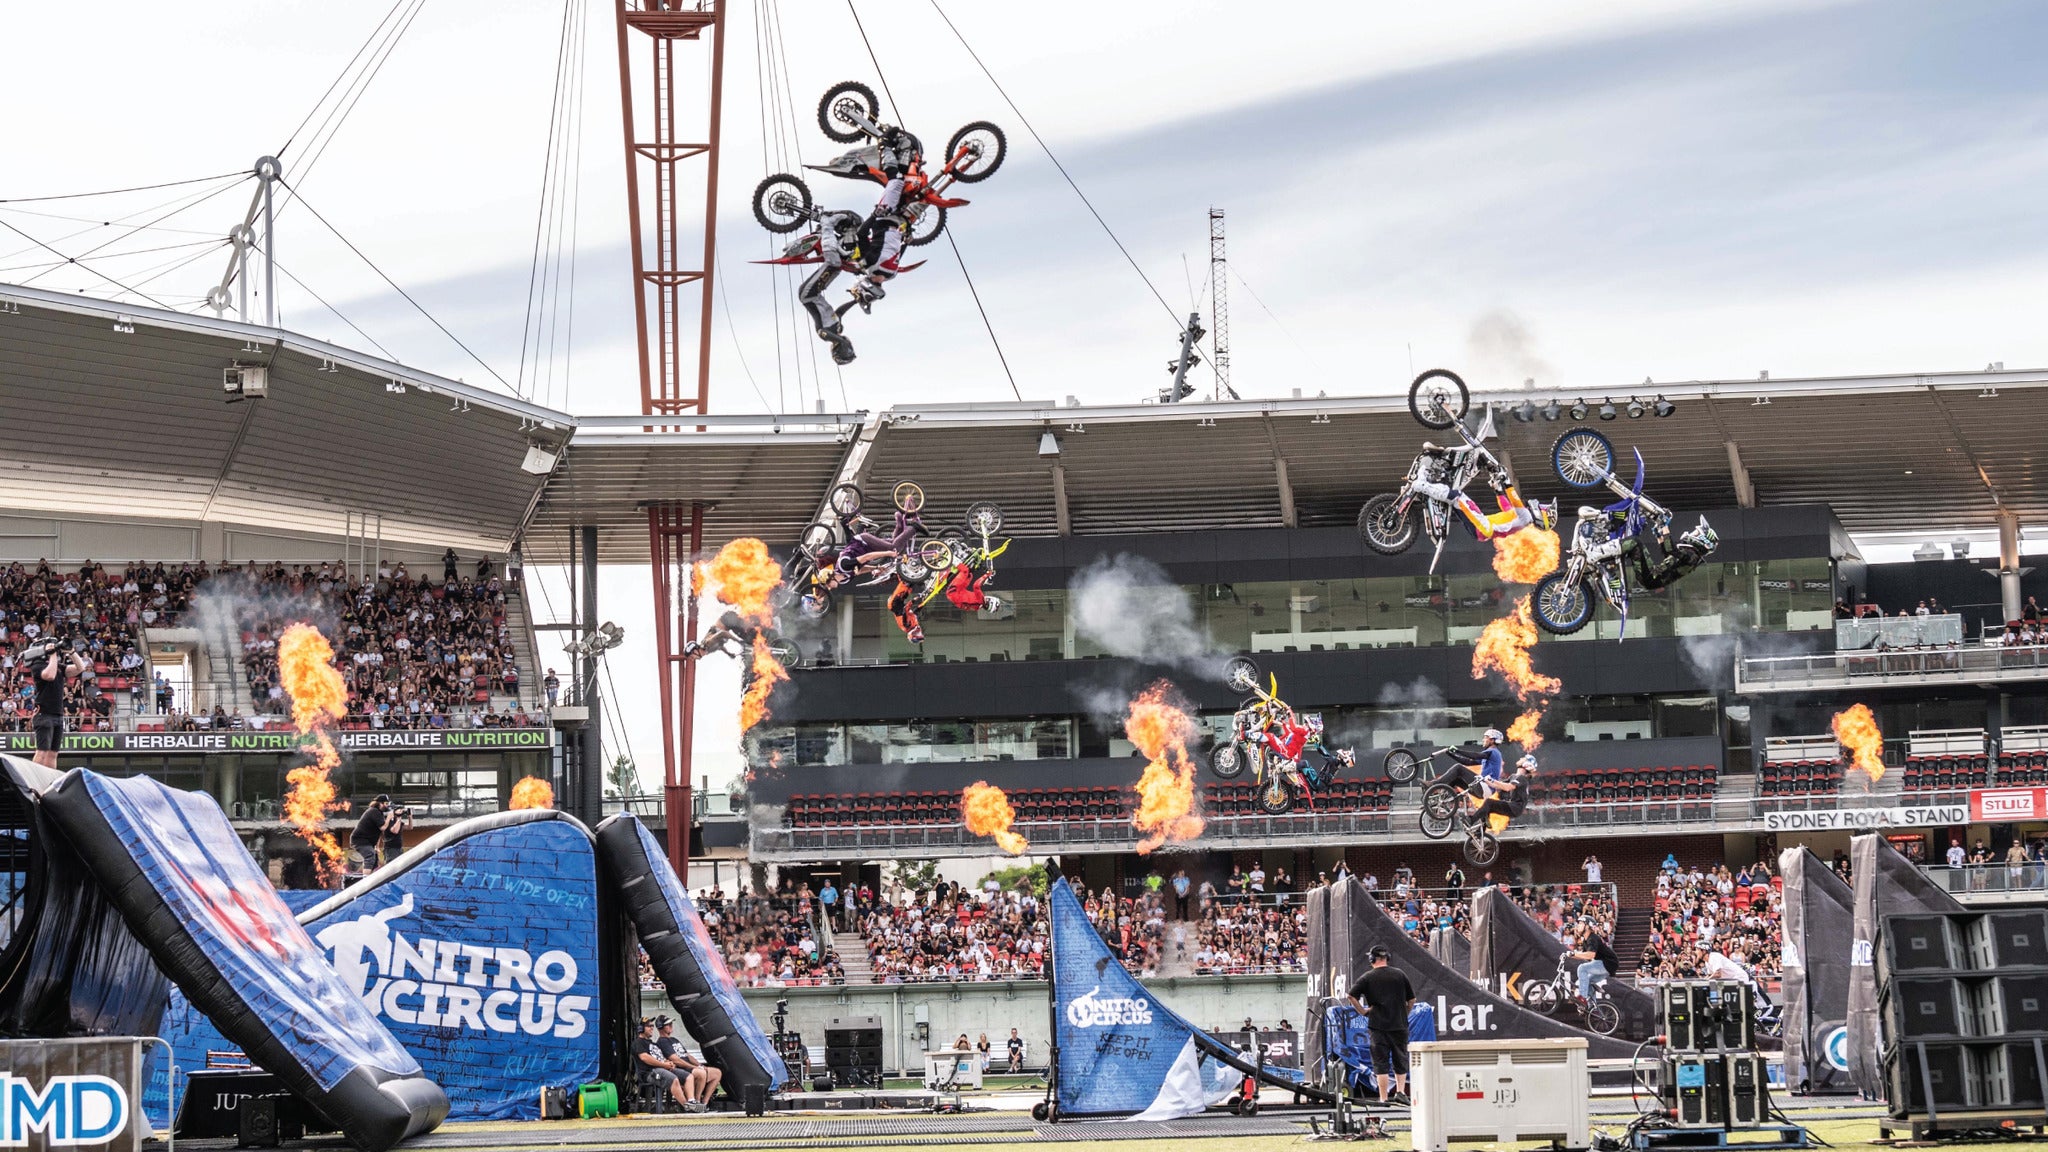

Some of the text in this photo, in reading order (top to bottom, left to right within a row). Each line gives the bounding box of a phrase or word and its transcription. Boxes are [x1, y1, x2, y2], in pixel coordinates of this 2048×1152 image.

[126, 735, 227, 748] HERBALIFE
[341, 732, 545, 746] HERBALIFE NUTRITION
[1985, 799, 2030, 810] STULZ
[1767, 808, 1965, 829] SYDNEY ROYAL STAND
[427, 862, 589, 910] KEEP IT WIDE OPEN
[391, 931, 578, 994] NITRO
[1093, 998, 1149, 1012] NITRO
[1724, 991, 1738, 1003] 07
[383, 979, 592, 1039] CIRCUS
[1092, 1010, 1153, 1026] CIRCUS
[1101, 1031, 1151, 1049] KEEP IT
[1095, 1041, 1152, 1062] WIDE OPEN
[503, 1052, 553, 1077] RULE
[1738, 1065, 1750, 1077] 12
